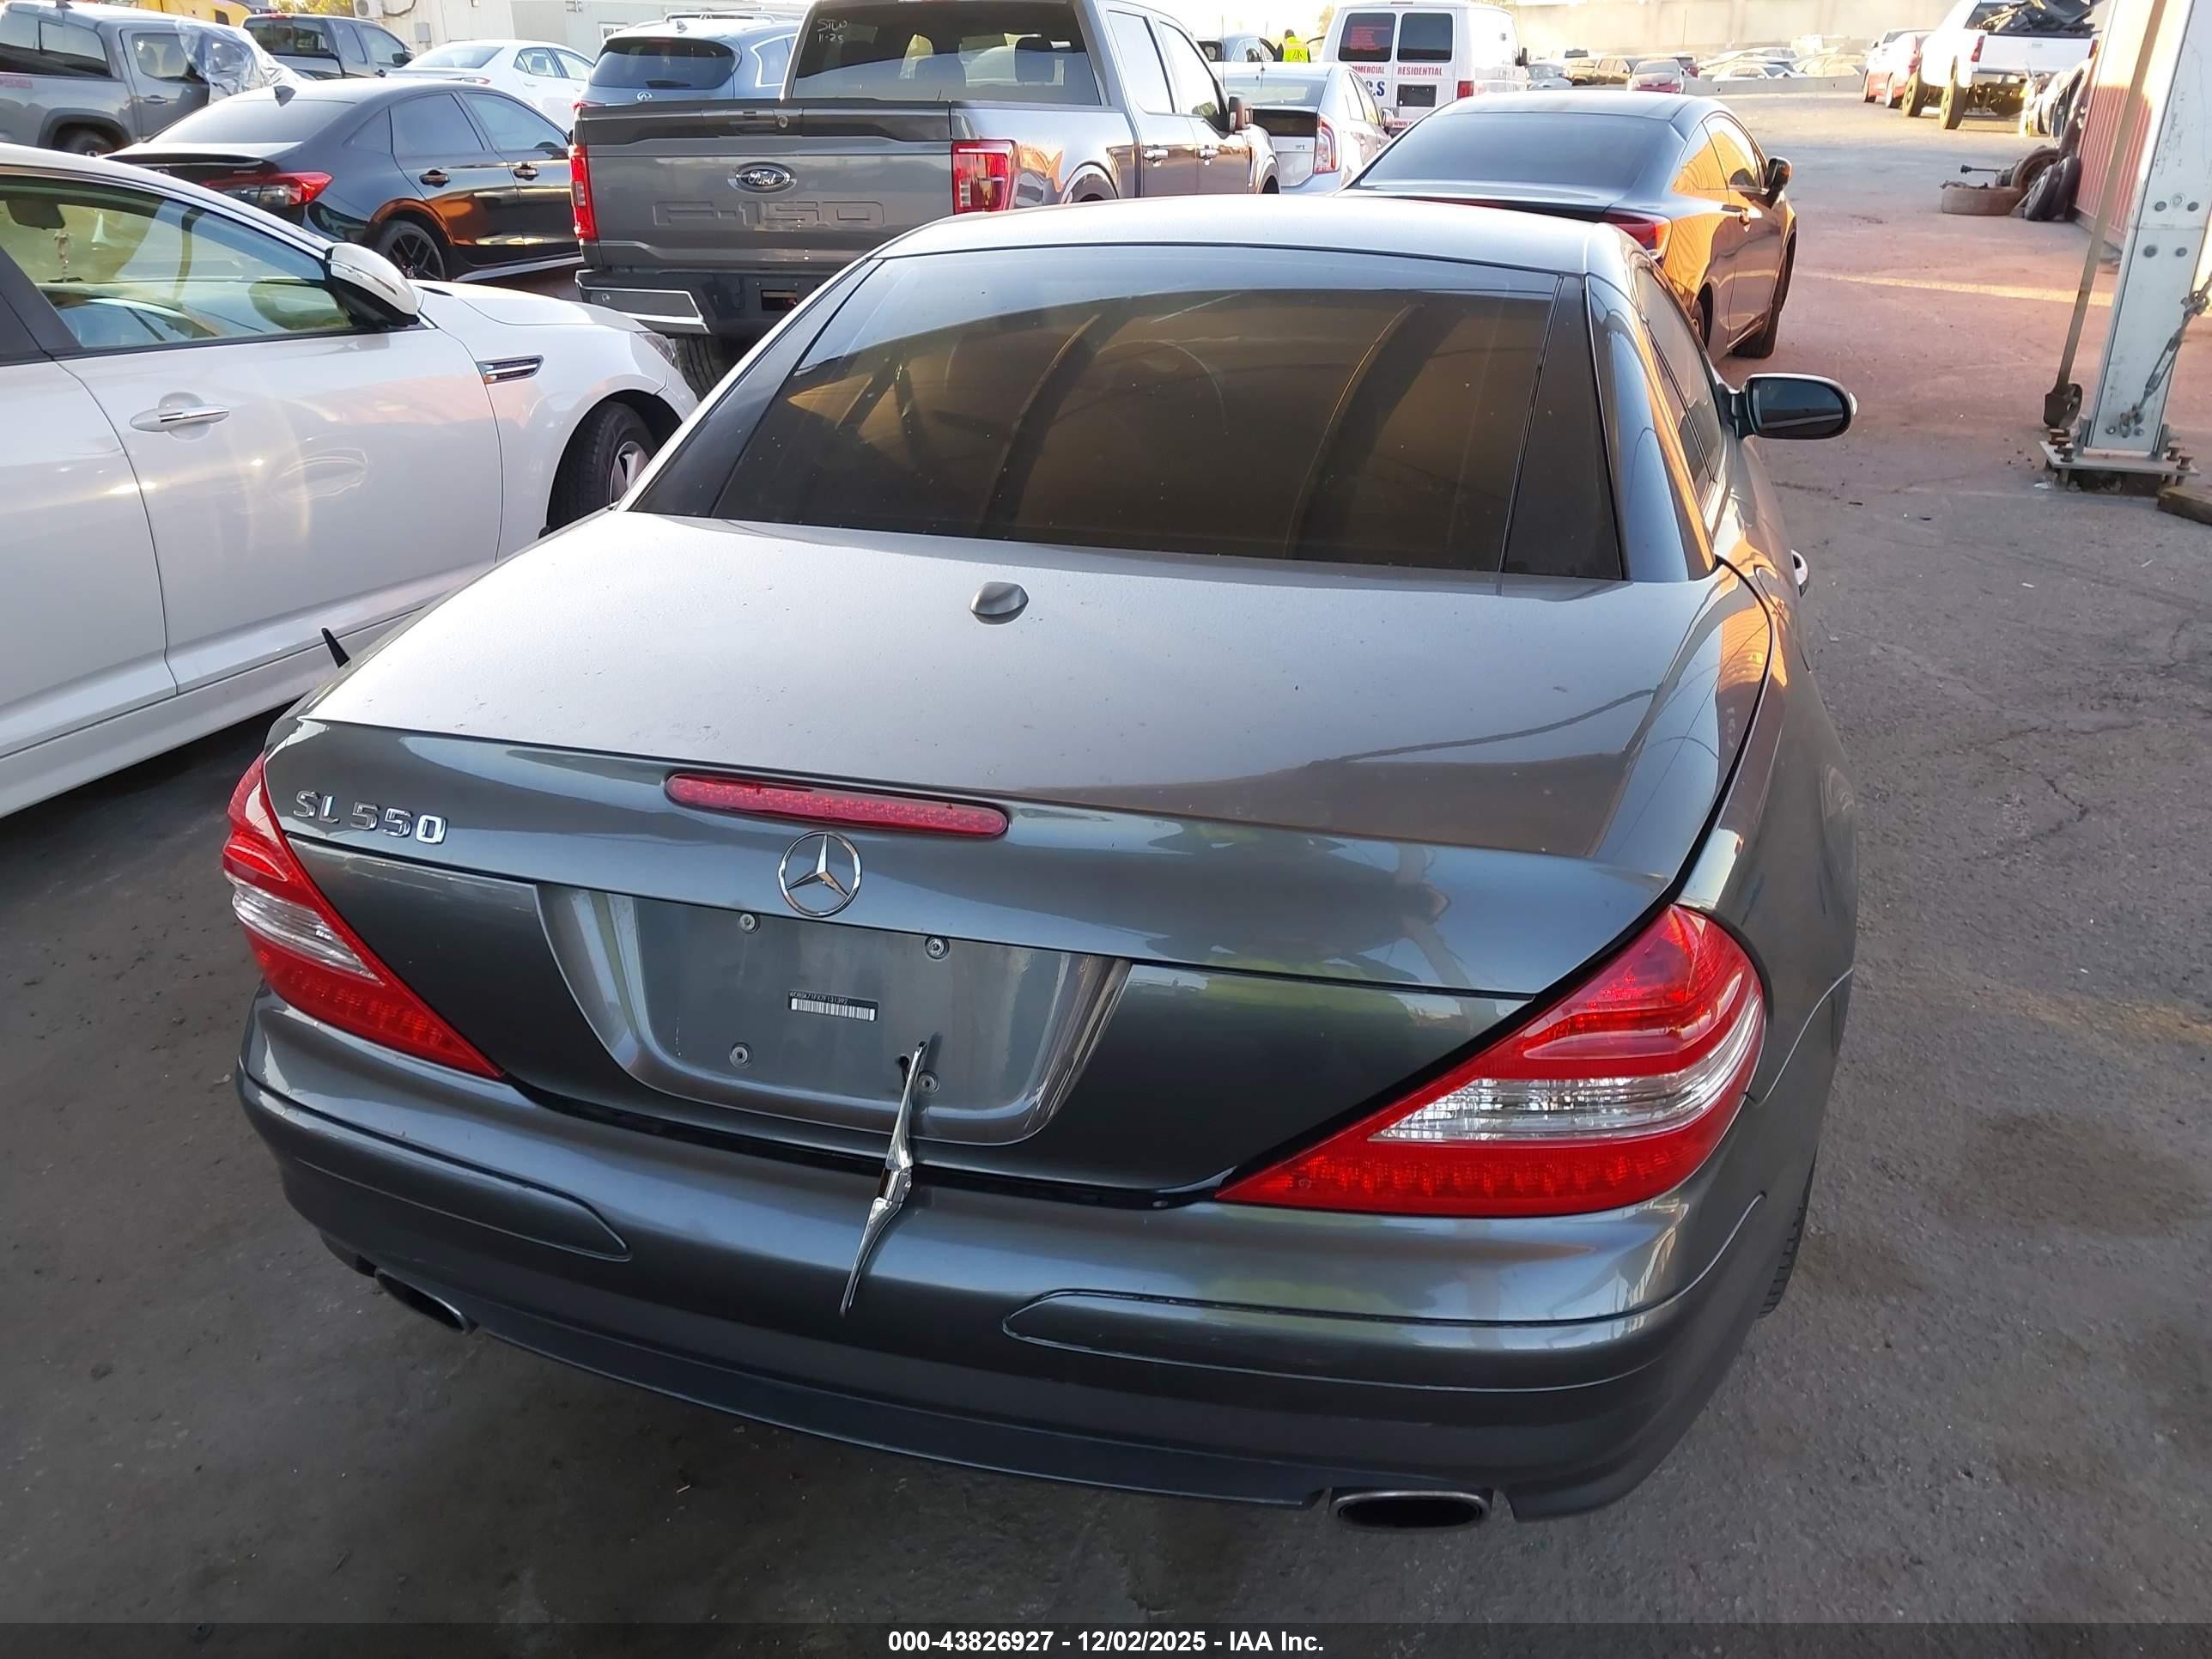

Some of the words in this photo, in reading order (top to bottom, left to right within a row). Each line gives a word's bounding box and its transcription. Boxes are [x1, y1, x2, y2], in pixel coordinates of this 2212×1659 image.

[1398, 66, 1442, 76] RESIDENTIAL
[748, 171, 776, 185] Ford
[653, 200, 885, 229] F-150
[293, 789, 341, 824] SL
[349, 801, 447, 844] 550
